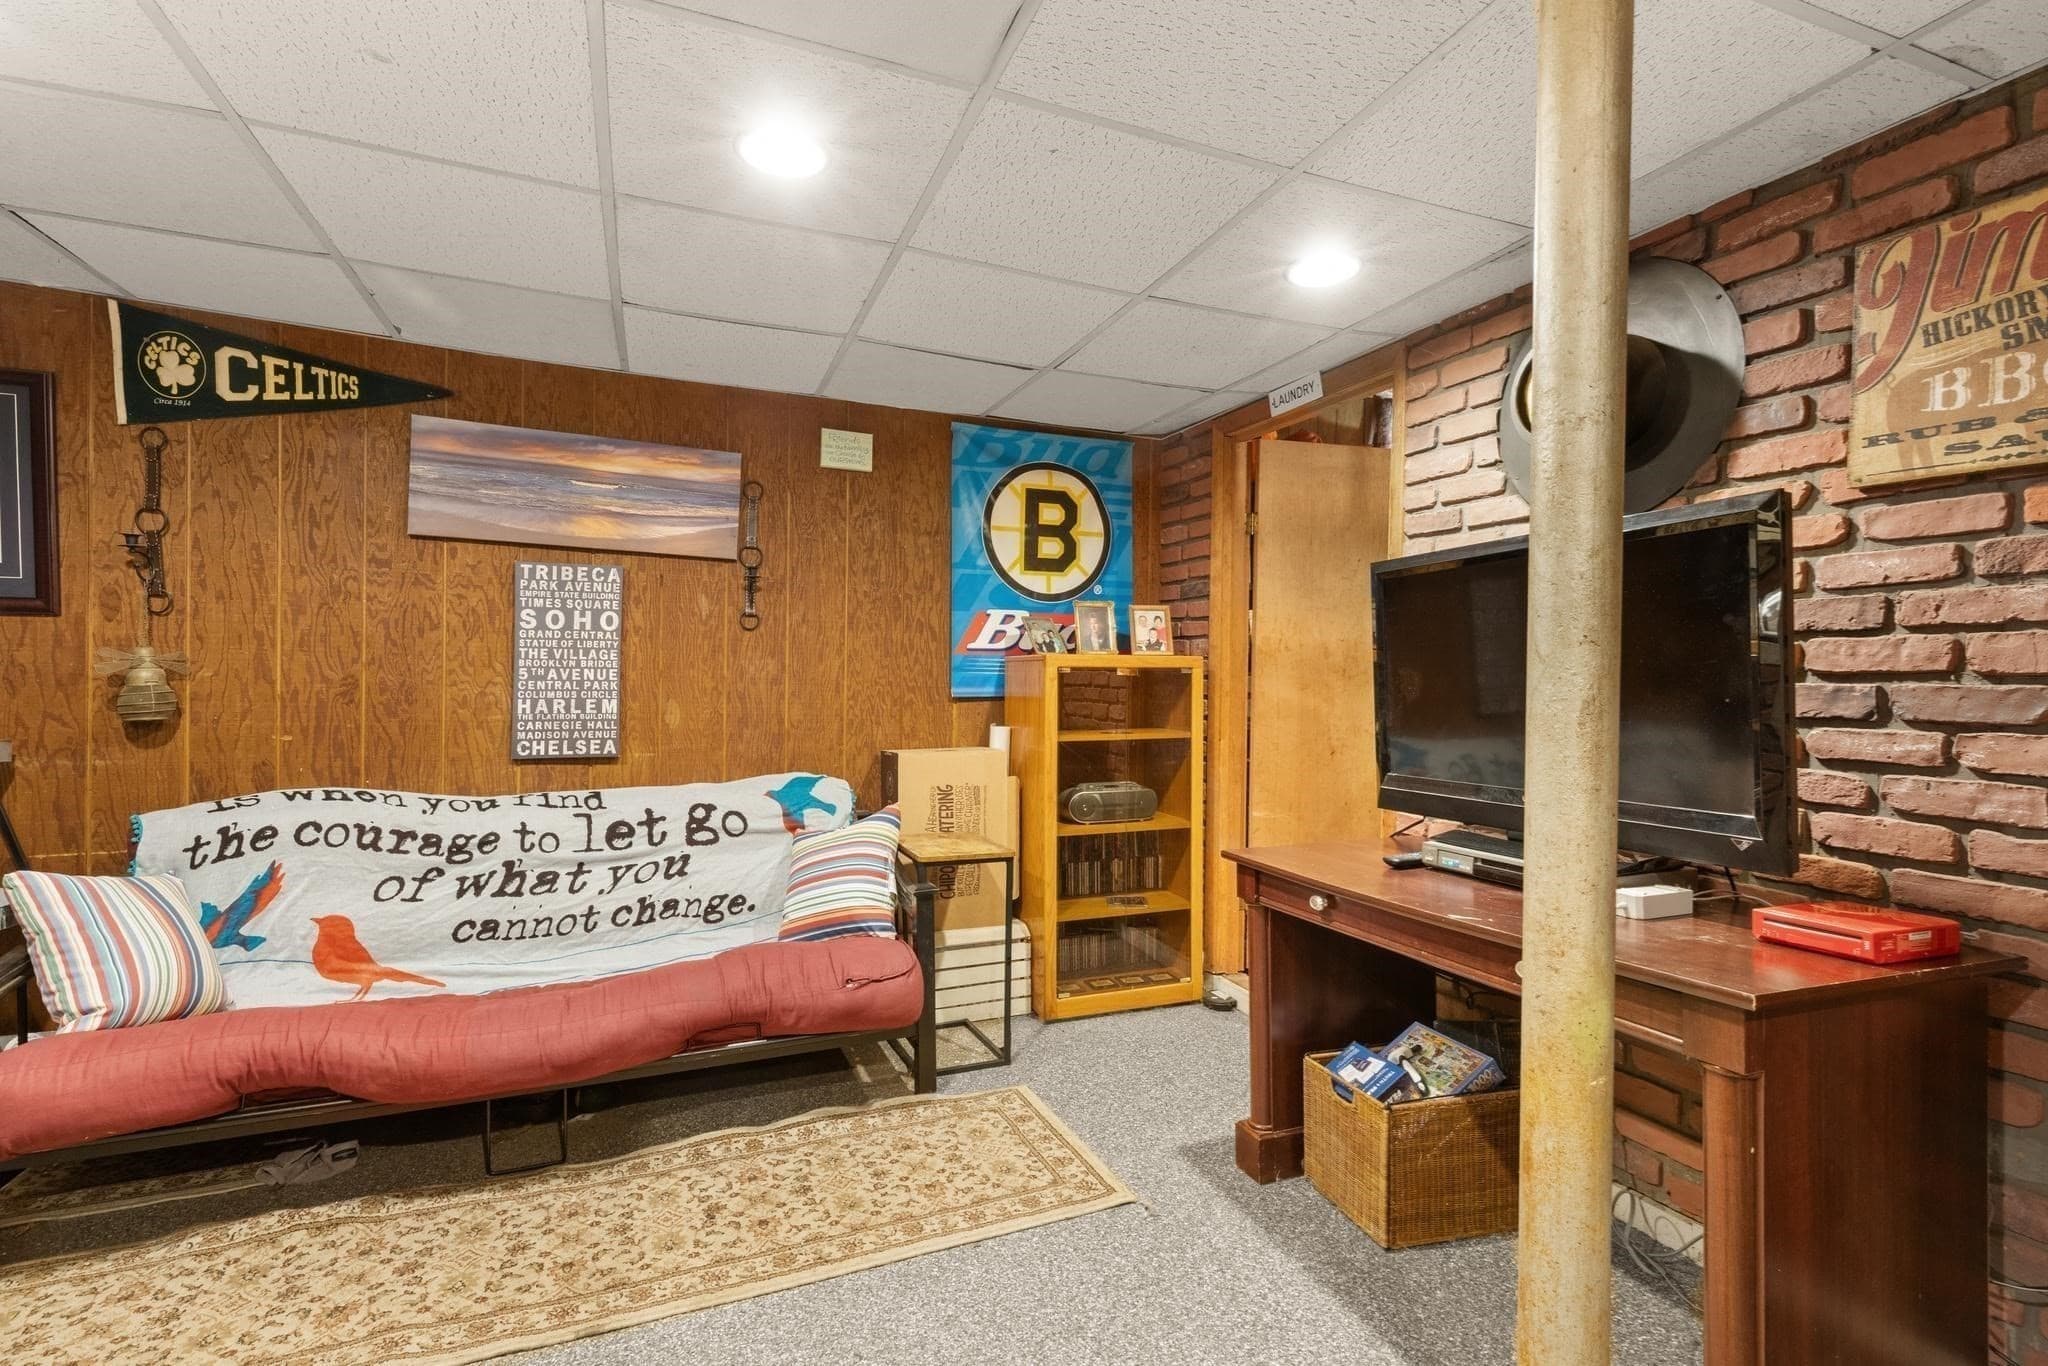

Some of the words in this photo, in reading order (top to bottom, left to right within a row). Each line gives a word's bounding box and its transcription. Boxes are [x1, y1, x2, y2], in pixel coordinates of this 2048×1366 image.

[144, 336, 200, 370] CELTICS
[214, 346, 359, 402] CELTICS
[1920, 352, 2048, 412] BB
[1272, 381, 1314, 408] LAUNDRY
[1862, 416, 1998, 448] RUB
[1021, 485, 1080, 574] B
[520, 564, 620, 582] TRIBECA
[520, 580, 558, 590] PARK
[565, 582, 620, 592] AVENUE
[520, 590, 552, 598] EMPIRE
[582, 592, 620, 600] BUILDING
[520, 598, 561, 608] TIMES
[566, 599, 620, 610] SQUARE
[520, 608, 619, 631] SOHO
[520, 630, 561, 638] GRAND
[564, 630, 619, 640] CENTRAL
[561, 640, 574, 648] OF
[577, 640, 619, 648] LIBERTY
[519, 648, 548, 659] THE
[553, 648, 618, 660] VILLAGE
[580, 660, 618, 668] BRIDGE
[547, 668, 618, 680] AVENUE
[518, 681, 579, 690] CENTRAL
[584, 681, 618, 690] PARK
[518, 691, 577, 699] COLUMBUS
[580, 691, 618, 699] CIRCLE
[517, 699, 618, 714] HARLEM
[517, 721, 582, 730] CARNEGIE
[587, 721, 617, 729] HALL
[517, 731, 569, 740] MADISON
[516, 740, 616, 756] CHELSEA
[419, 796, 500, 815] you
[937, 784, 954, 833] ATERING
[183, 822, 280, 870] the
[293, 820, 500, 865] courage
[513, 820, 560, 854] to
[573, 808, 667, 853] let
[685, 802, 748, 846] go
[374, 867, 446, 902] of
[455, 859, 593, 902] what
[597, 850, 691, 896] you
[939, 864, 955, 899] CHIPO
[451, 905, 601, 944] cannot
[611, 892, 756, 927] change.
